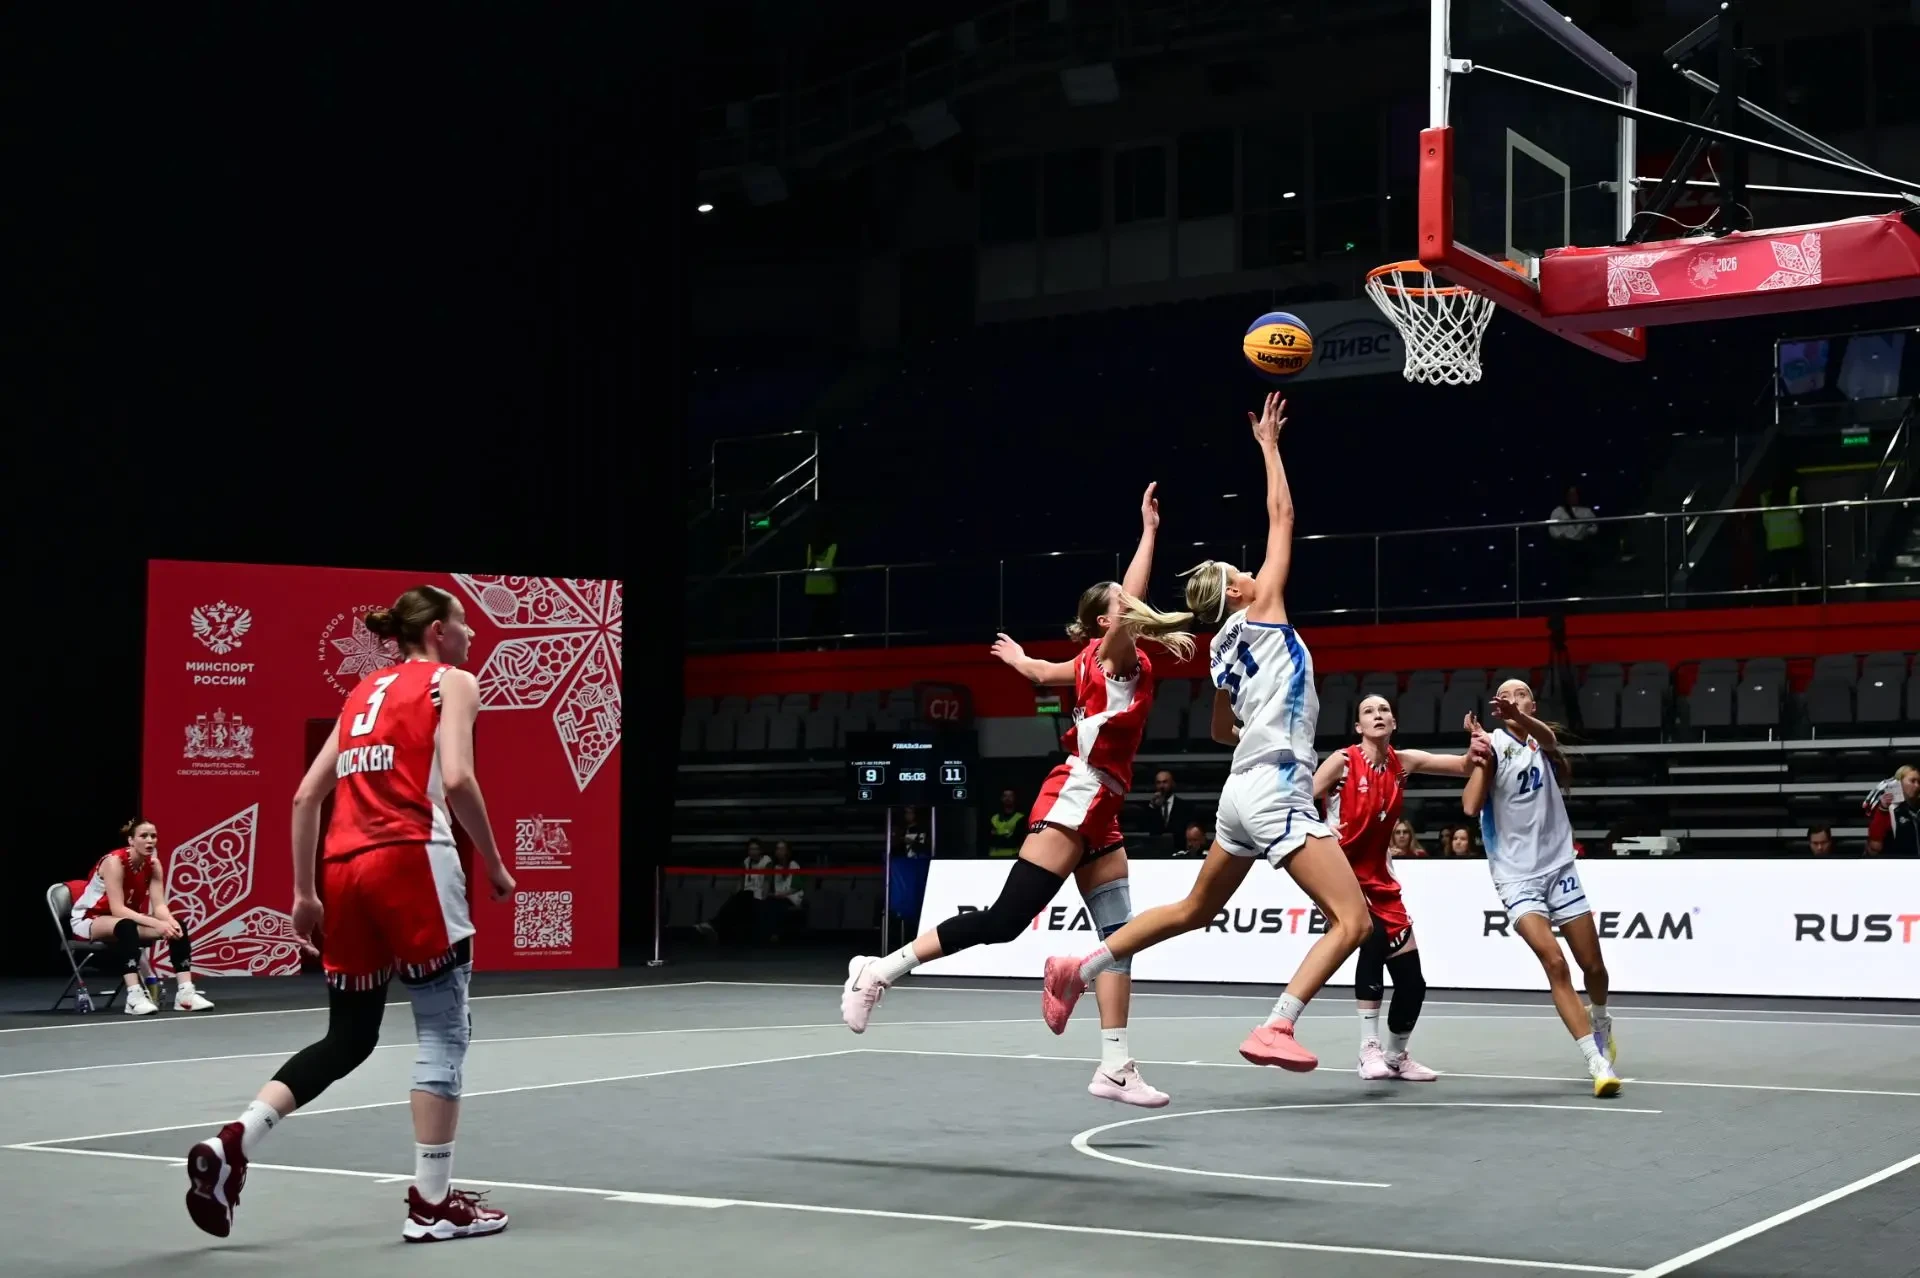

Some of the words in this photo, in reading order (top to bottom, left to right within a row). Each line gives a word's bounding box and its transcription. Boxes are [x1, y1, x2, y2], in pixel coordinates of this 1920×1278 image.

[1717, 256, 1737, 272] 2026
[1318, 332, 1391, 366] ДИВС
[1257, 351, 1303, 368] Wilson
[318, 613, 345, 661] НАРОДОВ
[186, 662, 255, 672] МИНСПОРТ
[194, 675, 246, 686] РОССИИ
[350, 672, 400, 737] 3
[866, 769, 877, 782] 9
[898, 772, 927, 782] 05:03
[945, 768, 962, 781] 11
[1517, 766, 1543, 794] 22
[956, 790, 962, 798] 2
[516, 824, 535, 837] 20
[516, 837, 534, 851] 26
[1559, 876, 1578, 894] 22
[1205, 908, 1328, 934] RUSTE
[1482, 910, 1693, 939] REAM
